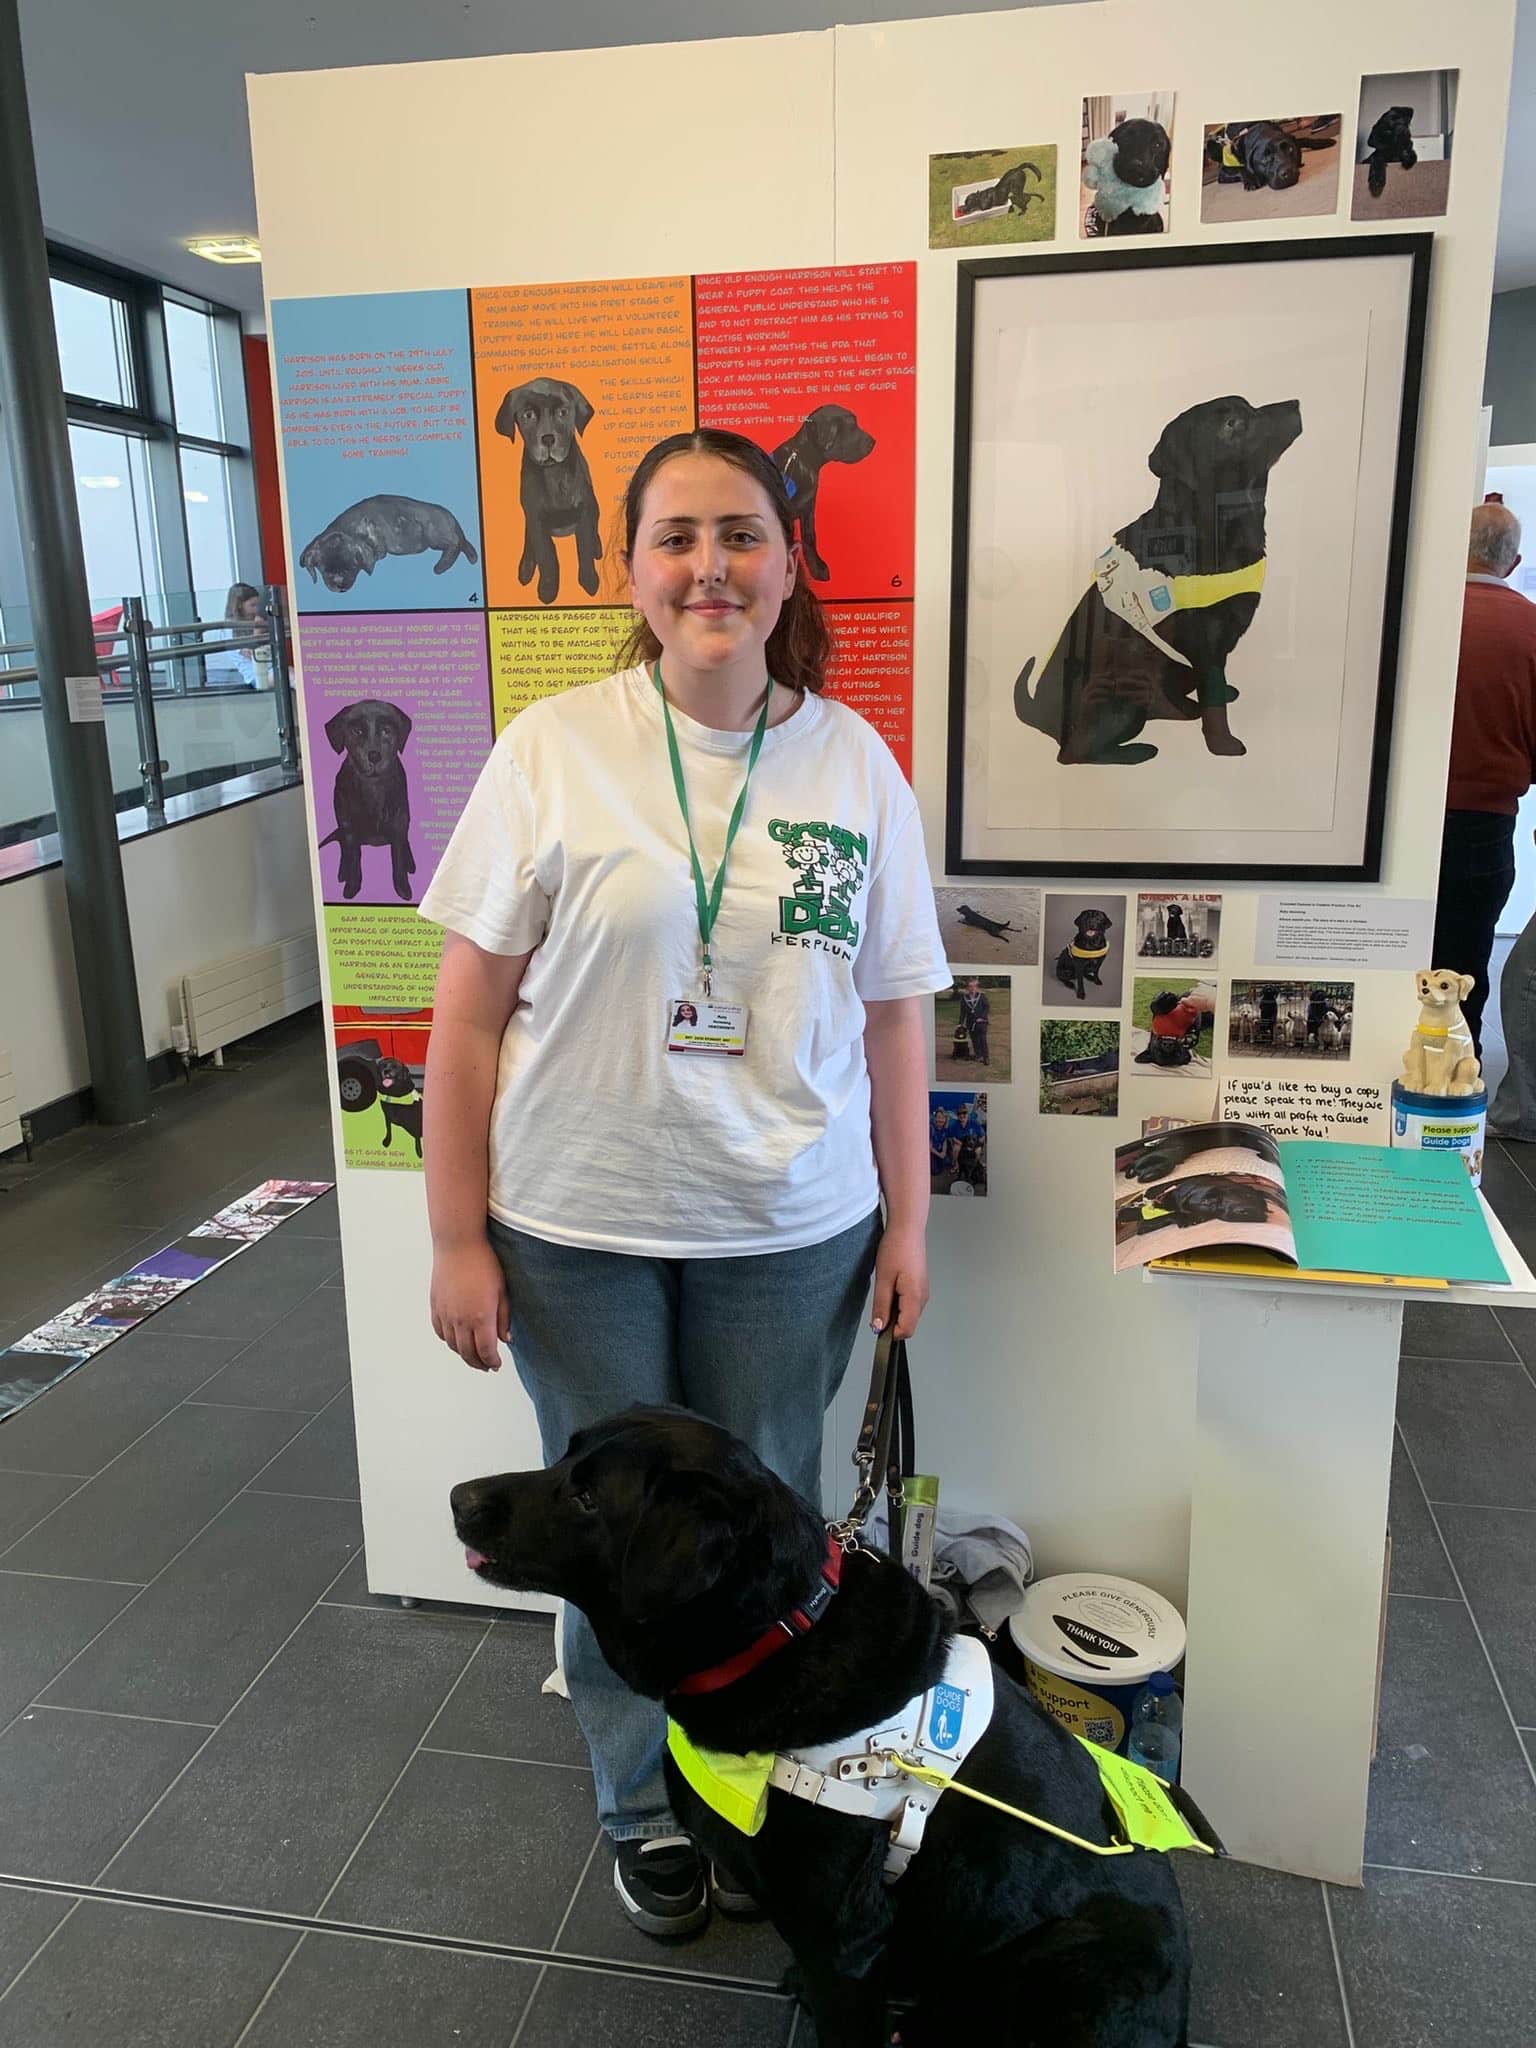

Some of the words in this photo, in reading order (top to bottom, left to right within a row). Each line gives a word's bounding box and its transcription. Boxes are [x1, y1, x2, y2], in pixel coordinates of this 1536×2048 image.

[890, 574, 902, 588] 6
[468, 592, 479, 604] 4
[496, 613, 540, 621] HARRISON
[562, 612, 597, 620] PASSED
[599, 612, 615, 620] ALL
[831, 612, 851, 621] NOW
[853, 611, 901, 620] QUALIFIED
[501, 627, 523, 635] THAT
[526, 627, 537, 635] HE
[540, 626, 549, 634] IS
[552, 626, 580, 634] READY
[583, 626, 600, 634] FOR
[603, 626, 619, 634] THE
[862, 626, 877, 634] HIS
[879, 625, 908, 634] WHITE
[501, 640, 537, 648] WAITING
[540, 640, 550, 648] TO
[552, 640, 564, 648] BE
[566, 639, 608, 648] MATCHED
[854, 640, 878, 649] VERY
[880, 639, 911, 648] CLOSE
[535, 653, 561, 661] START
[565, 653, 603, 661] WORKING
[862, 653, 907, 662] HARRISON
[501, 667, 542, 675] SOMEONE
[566, 666, 595, 674] NEEDS
[854, 666, 911, 675] CONFIDENCE
[534, 680, 544, 688] TO
[546, 680, 563, 688] GET
[841, 680, 881, 689] OUTINGS
[846, 694, 891, 702] HARRISON
[1228, 1080, 1238, 1091] If
[1241, 1080, 1272, 1094] you'd
[1278, 1081, 1299, 1092] like
[1304, 1084, 1317, 1092] to
[1321, 1082, 1341, 1097] buy
[1345, 1086, 1352, 1094] a
[1356, 1087, 1379, 1099] copy
[1224, 1095, 1257, 1105] please
[1264, 1095, 1295, 1106] speak
[1300, 1097, 1312, 1105] to
[1316, 1098, 1337, 1107] me!
[1340, 1099, 1365, 1112] They
[1365, 1102, 1383, 1110] are
[1245, 1110, 1270, 1120] with
[1274, 1109, 1287, 1119] all
[1290, 1111, 1318, 1123] profit
[1322, 1114, 1335, 1122] to
[1336, 1113, 1369, 1124] Guide
[1260, 1123, 1299, 1136] Thank
[1302, 1126, 1329, 1139] You!
[1423, 1125, 1451, 1134] Please
[1423, 1137, 1450, 1146] Guide
[914, 1512, 925, 1529] dog
[911, 1531, 920, 1557] Guide
[1061, 1590, 1098, 1602] PLEASE
[1100, 1591, 1122, 1602] GIVE
[1123, 1599, 1157, 1639] GENEROUSLY
[1066, 1622, 1096, 1643] THANK
[1098, 1637, 1121, 1655] YOU!
[937, 1686, 962, 1702] GUIDE
[1040, 1687, 1090, 1710] support
[936, 1696, 960, 1712] DOGS
[1046, 1703, 1079, 1723] Dogs
